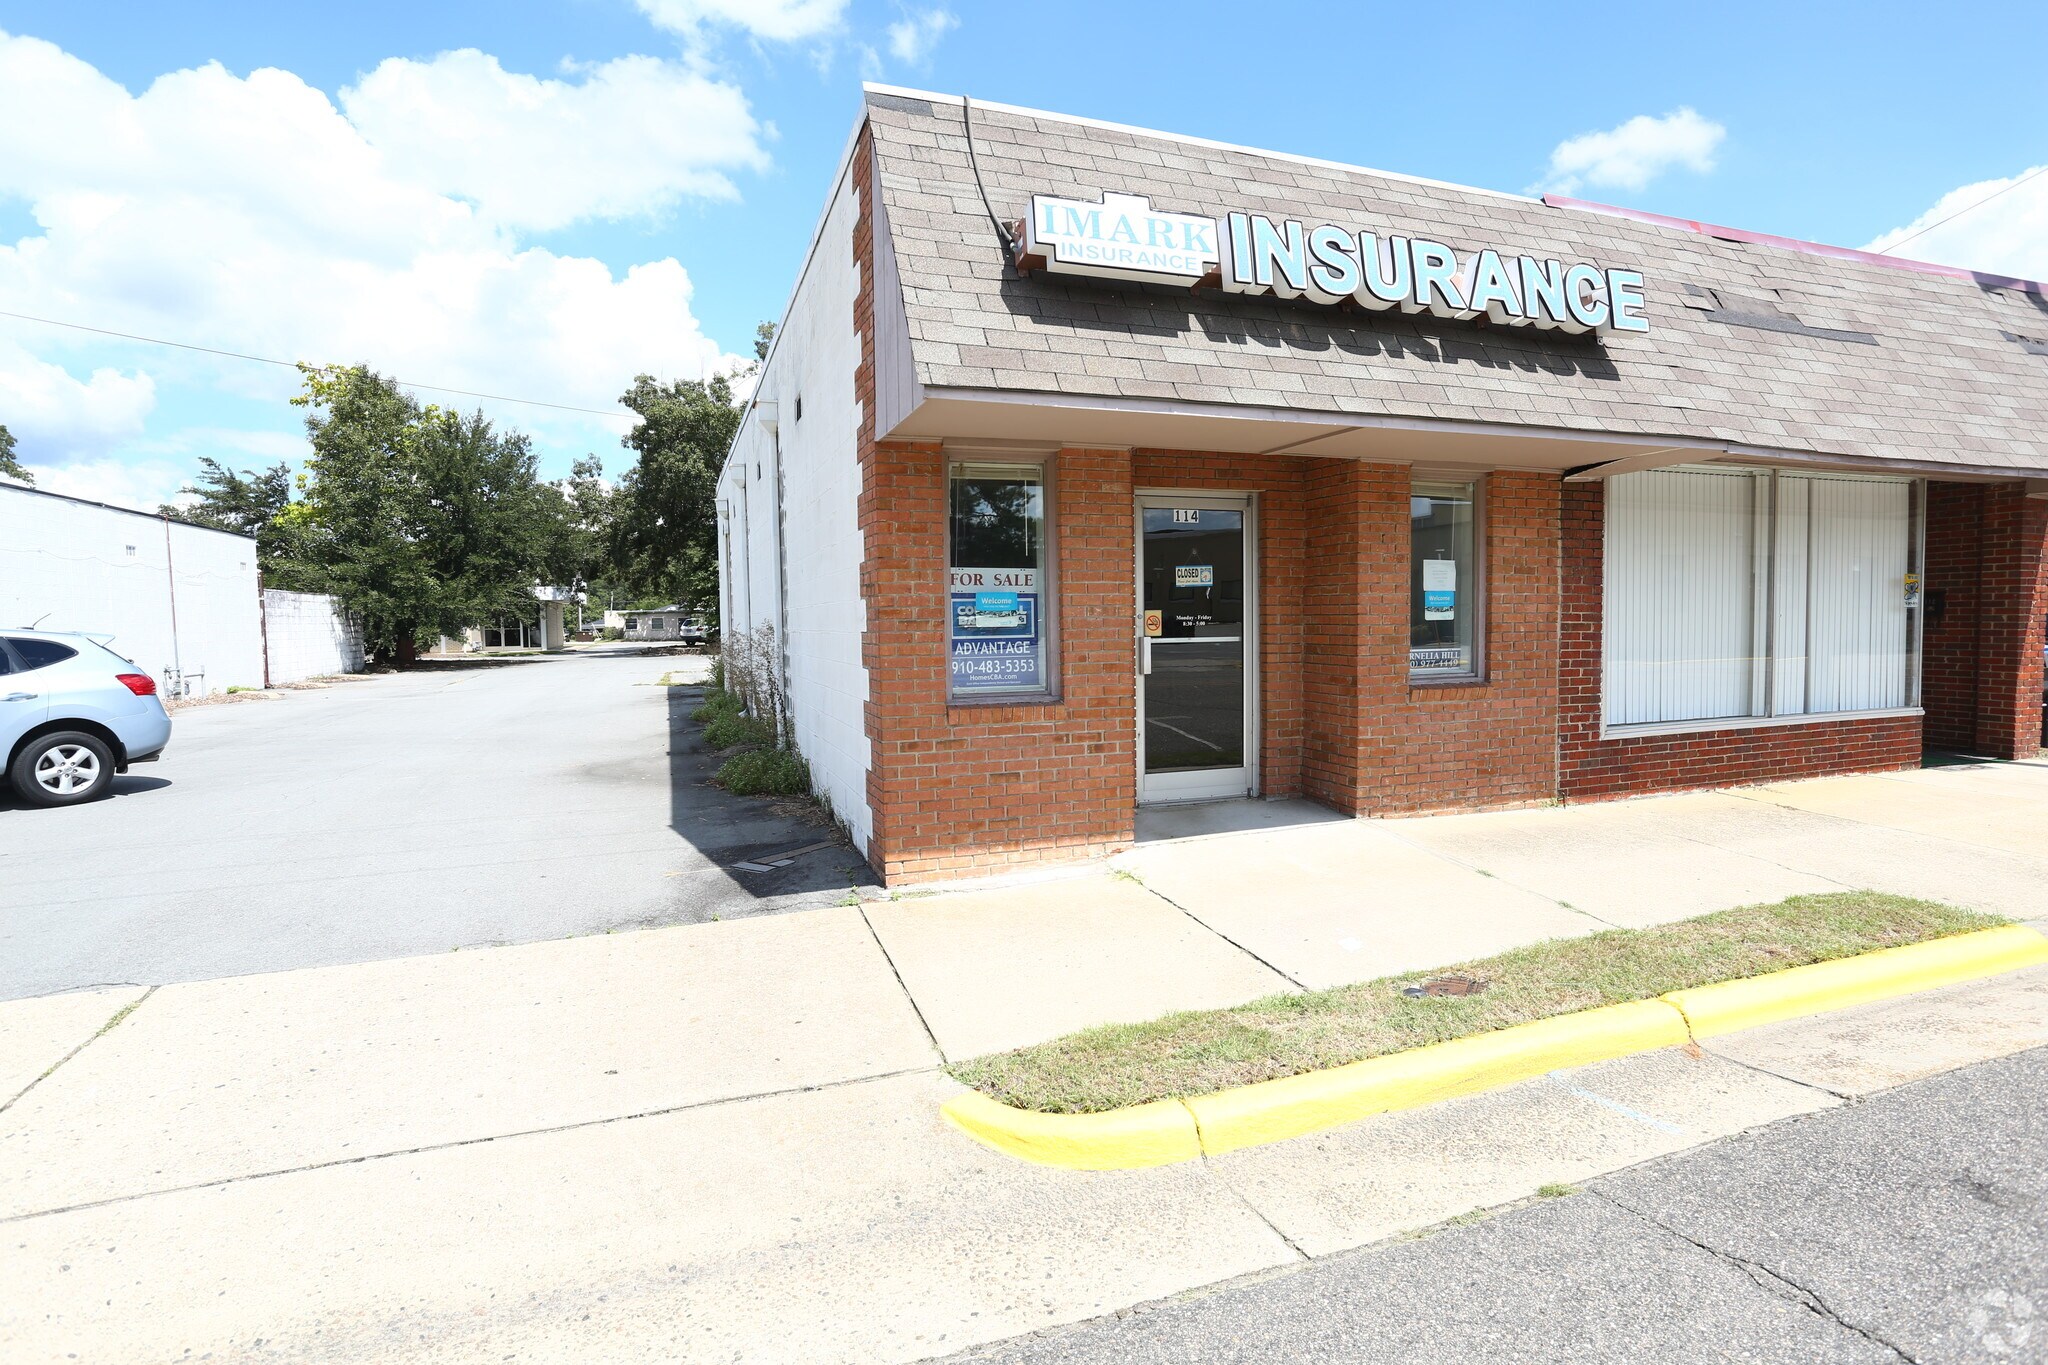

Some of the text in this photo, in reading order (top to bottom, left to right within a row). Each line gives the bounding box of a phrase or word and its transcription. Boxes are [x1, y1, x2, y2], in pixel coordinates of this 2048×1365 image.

[1040, 200, 1216, 254] IMARK
[1060, 241, 1199, 271] INSURANCE
[1231, 211, 1651, 334] INSURANCE
[1175, 510, 1199, 522] 114
[951, 573, 1033, 586] FOR SALE
[1177, 568, 1199, 578] CLOSED
[955, 641, 1031, 655] ADVANTAGE
[952, 659, 1035, 674] 910-483-5353
